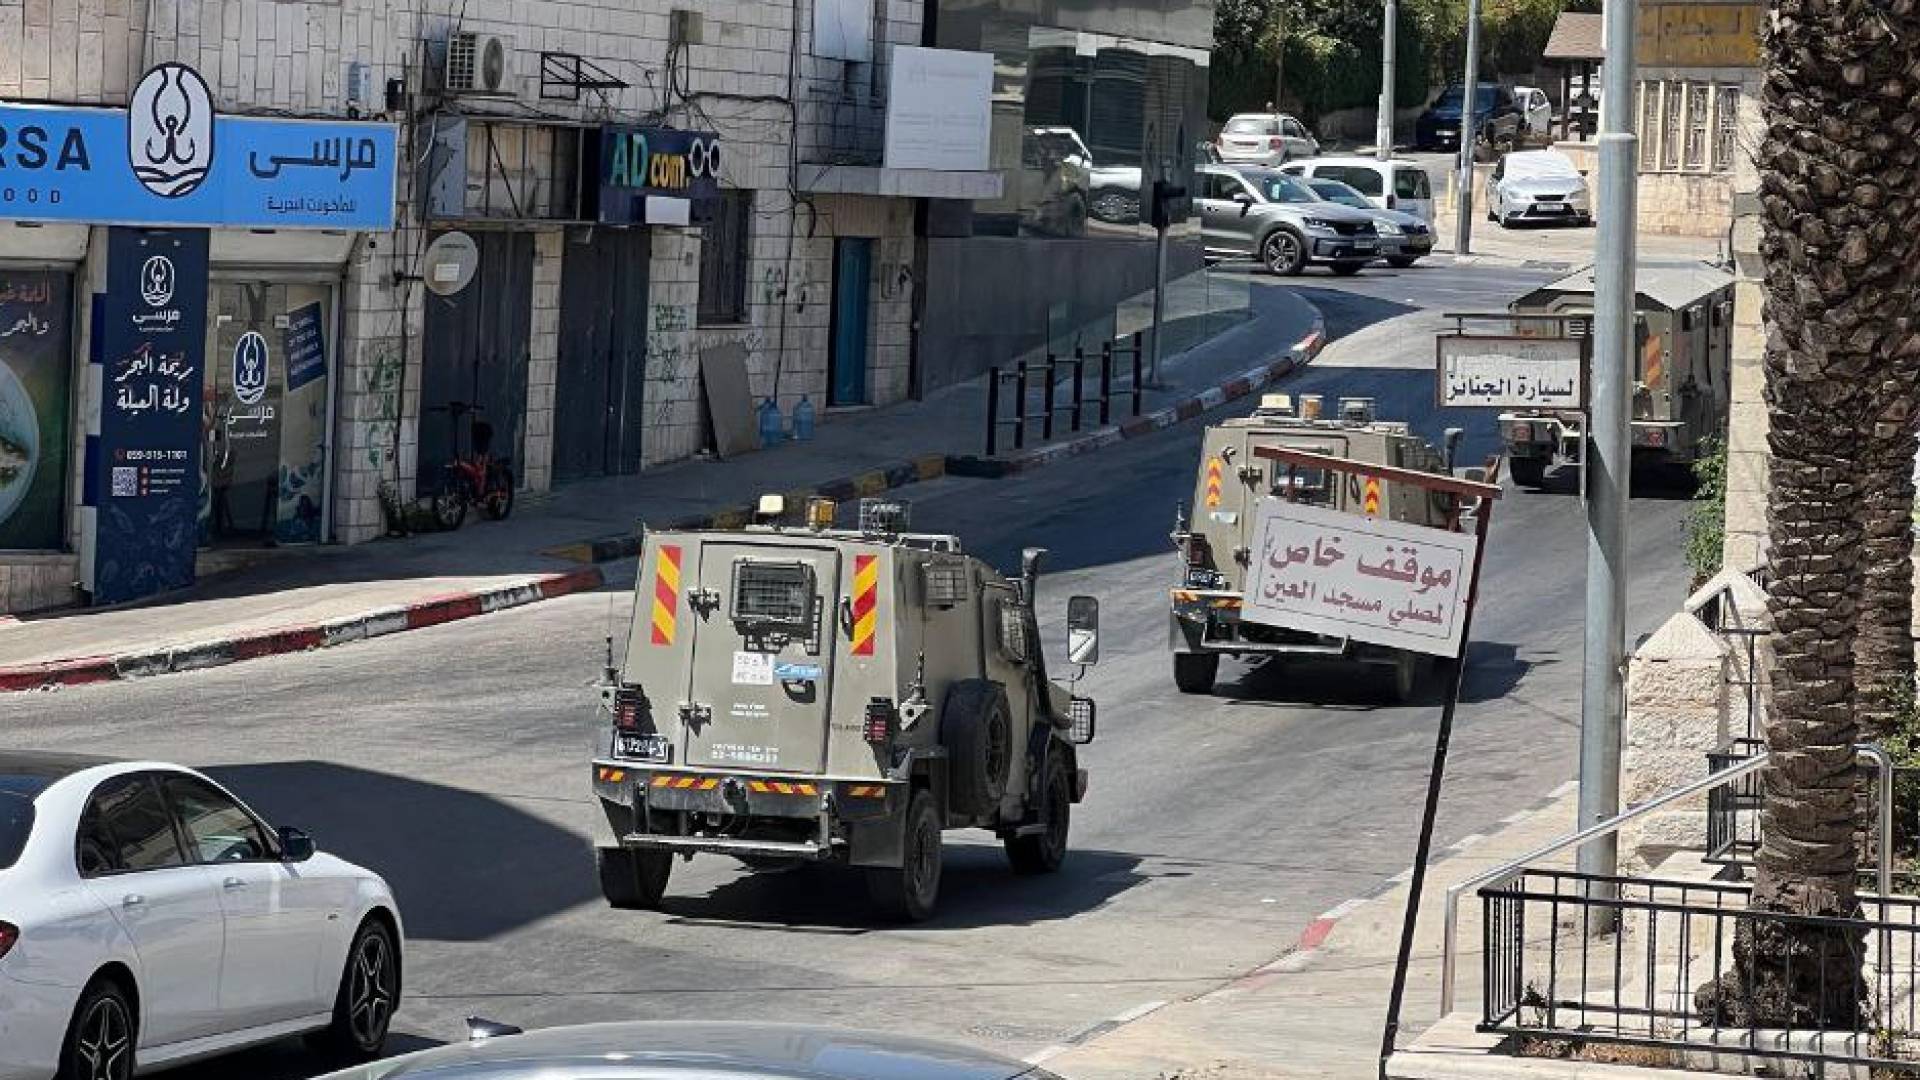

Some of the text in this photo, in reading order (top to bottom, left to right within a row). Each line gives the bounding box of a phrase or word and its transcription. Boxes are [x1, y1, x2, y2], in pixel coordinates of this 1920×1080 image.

[0, 126, 91, 170] SA
[249, 136, 376, 182] مرسى
[610, 132, 649, 188] AD
[1447, 373, 1574, 402] لسيارة الجنائز
[1268, 536, 1453, 595] موقف خاص
[1322, 587, 1383, 613] مسجد
